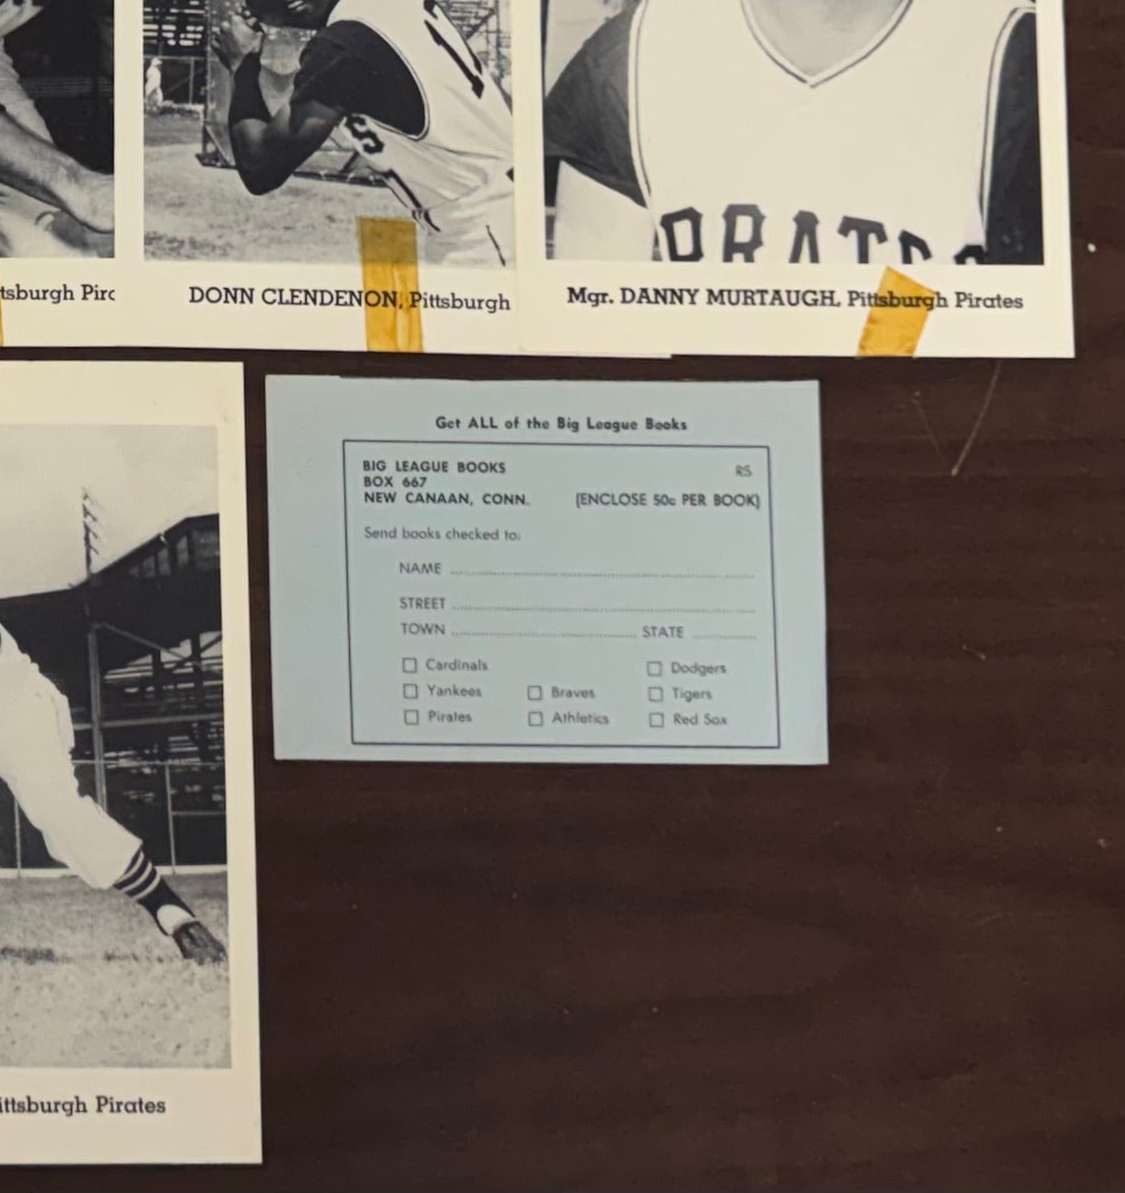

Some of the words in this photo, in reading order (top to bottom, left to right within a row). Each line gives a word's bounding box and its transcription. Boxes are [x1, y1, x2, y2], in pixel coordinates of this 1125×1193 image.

[189, 286, 255, 304] DONN
[261, 288, 403, 309] CLENDENON,
[409, 291, 511, 313] Pittsburgh
[566, 286, 614, 307] Mgr.
[620, 288, 699, 305] DANNY
[706, 289, 842, 308] MURTAUGH,
[847, 290, 948, 312] Pittsburgh
[955, 292, 1024, 309] Pirates
[435, 416, 461, 430] Get
[468, 417, 498, 430] ALL
[504, 417, 520, 430] of
[526, 417, 550, 430] the
[557, 417, 580, 433] Big
[586, 417, 638, 433] League
[645, 418, 688, 431] Books
[363, 460, 387, 472] BIG
[395, 461, 449, 473] LEAGUE
[457, 462, 506, 474] BOOKS
[363, 476, 394, 488] BOX
[402, 477, 427, 489] 667
[364, 492, 397, 504] NEW
[405, 492, 474, 506] CANAAN,
[482, 493, 531, 507] CONN.
[576, 492, 648, 509] (ENCLOSE
[682, 493, 707, 507] PER
[713, 493, 761, 510] BOOK)
[364, 526, 397, 540] Send
[402, 526, 442, 541] books
[445, 527, 500, 542] checked
[399, 562, 442, 575] NAME
[399, 597, 446, 610] STREET
[401, 622, 446, 636] TOWN
[642, 625, 684, 639] STATE
[426, 658, 489, 672] Cardinals
[670, 661, 728, 677] Dodgers
[427, 684, 483, 698] Yankees
[551, 686, 596, 699] Braves
[672, 687, 713, 703] Tigers
[428, 710, 473, 723] Pirates
[551, 711, 610, 725] Athletics
[673, 713, 699, 726] Red
[703, 713, 729, 726] Sox
[95, 1096, 166, 1114] Pirates
